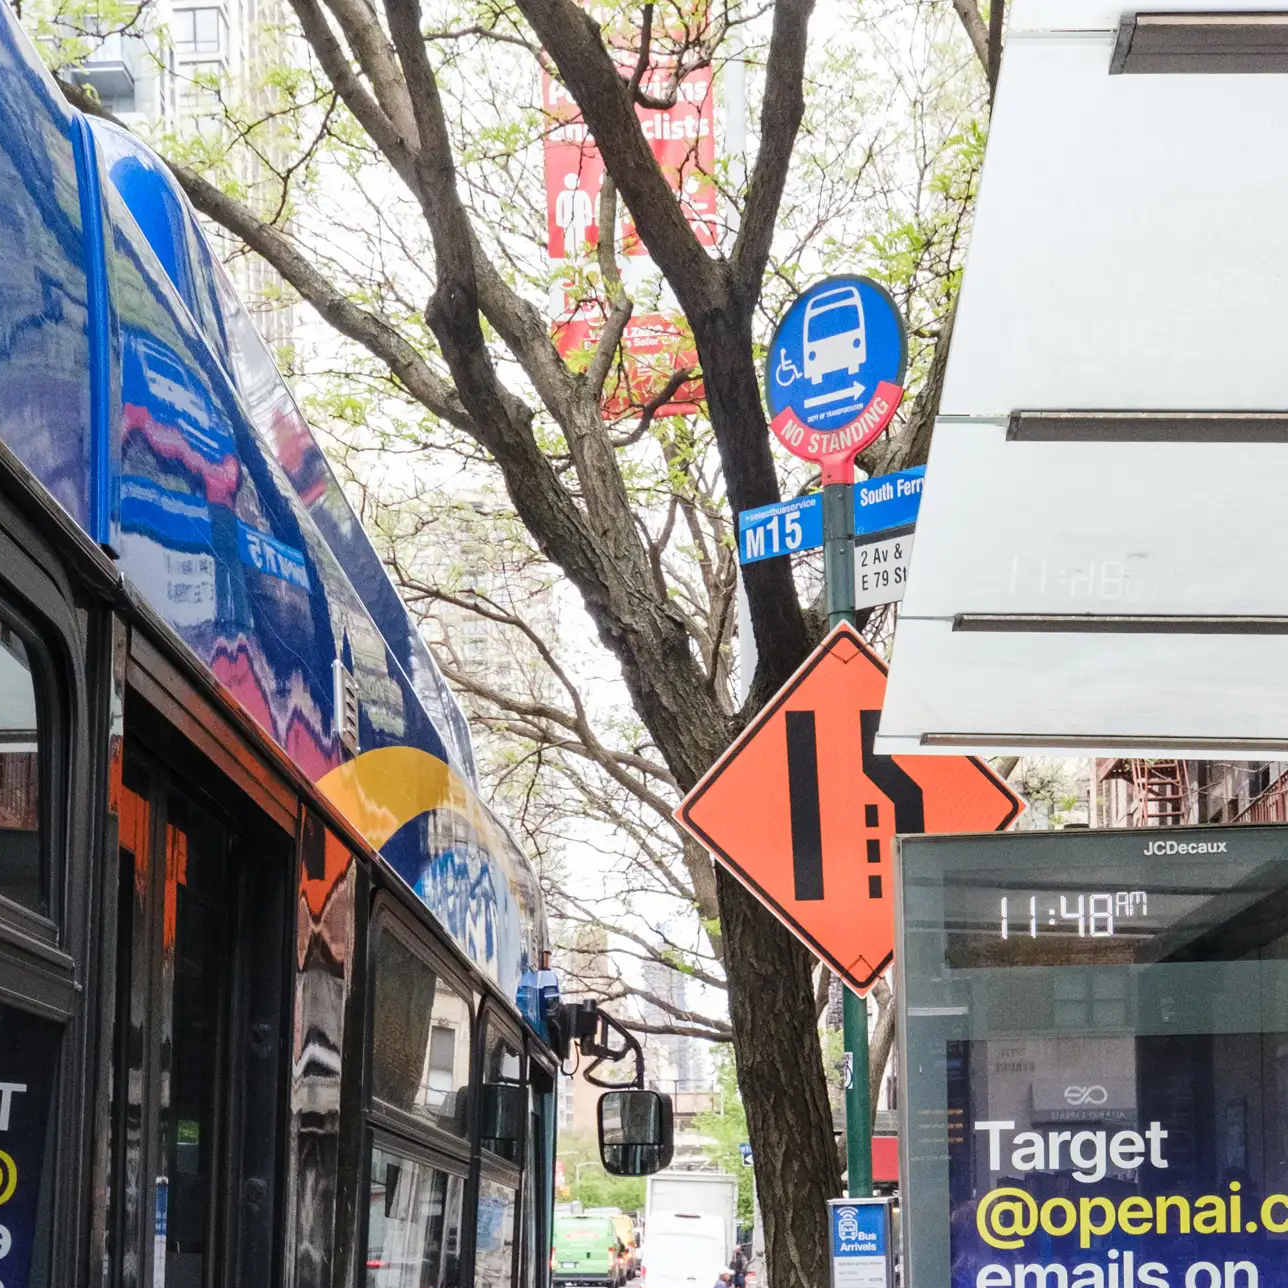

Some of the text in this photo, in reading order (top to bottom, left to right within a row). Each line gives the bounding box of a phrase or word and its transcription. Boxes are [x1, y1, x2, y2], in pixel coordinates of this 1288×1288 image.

[549, 113, 710, 143] an clists
[780, 396, 890, 454] NO STANDING
[860, 481, 894, 507] South
[745, 510, 803, 559] M15
[861, 542, 903, 568] 2 Av &
[861, 574, 869, 592] E
[873, 569, 889, 589] 79
[1143, 840, 1228, 857] JCDecaux
[999, 892, 1115, 940] 11:48
[973, 1120, 1169, 1184] Target
[840, 1242, 877, 1252] Arrivals
[857, 1231, 877, 1241] Bus
